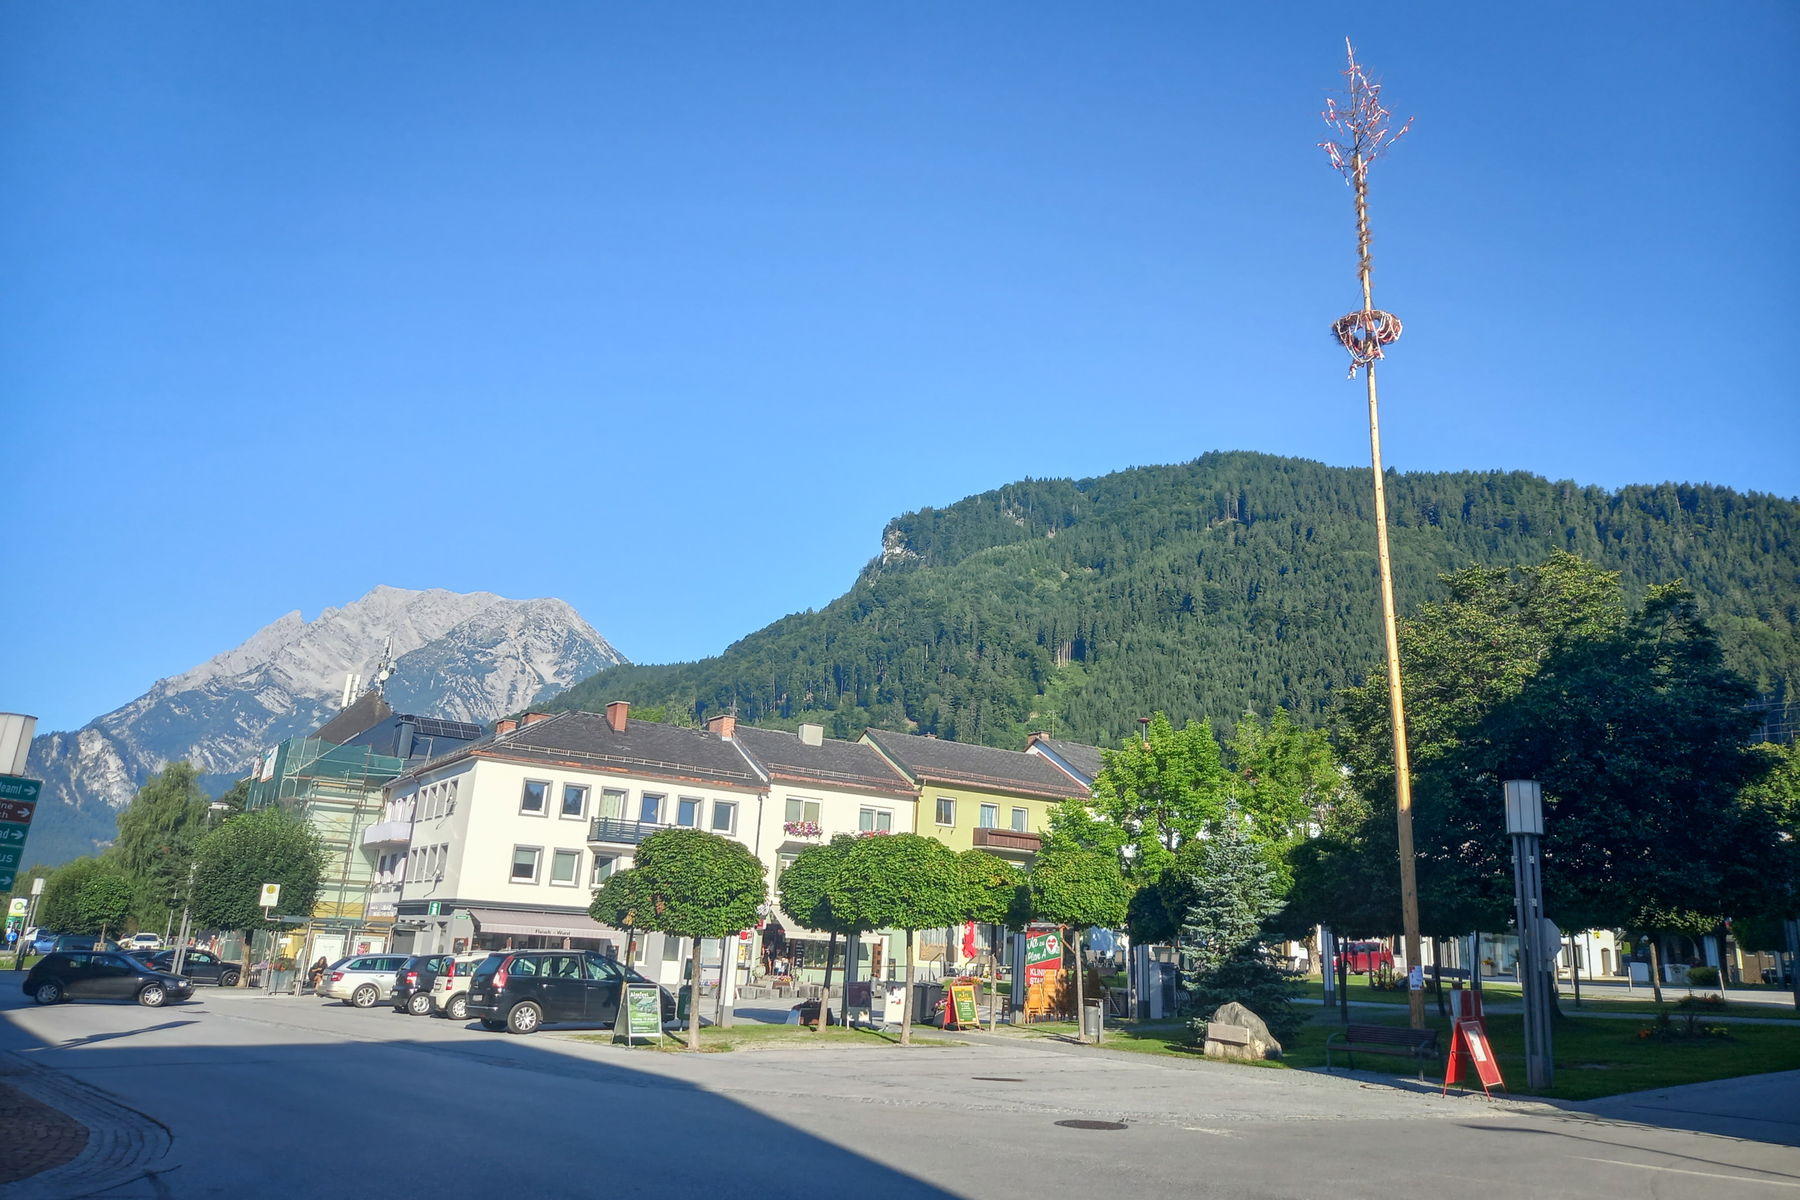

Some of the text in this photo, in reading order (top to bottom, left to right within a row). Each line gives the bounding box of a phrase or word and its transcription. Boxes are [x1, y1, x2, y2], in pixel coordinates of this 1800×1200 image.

[0, 802, 13, 810] ne
[1028, 952, 1041, 961] Plan
[1030, 968, 1046, 976] KLINI
